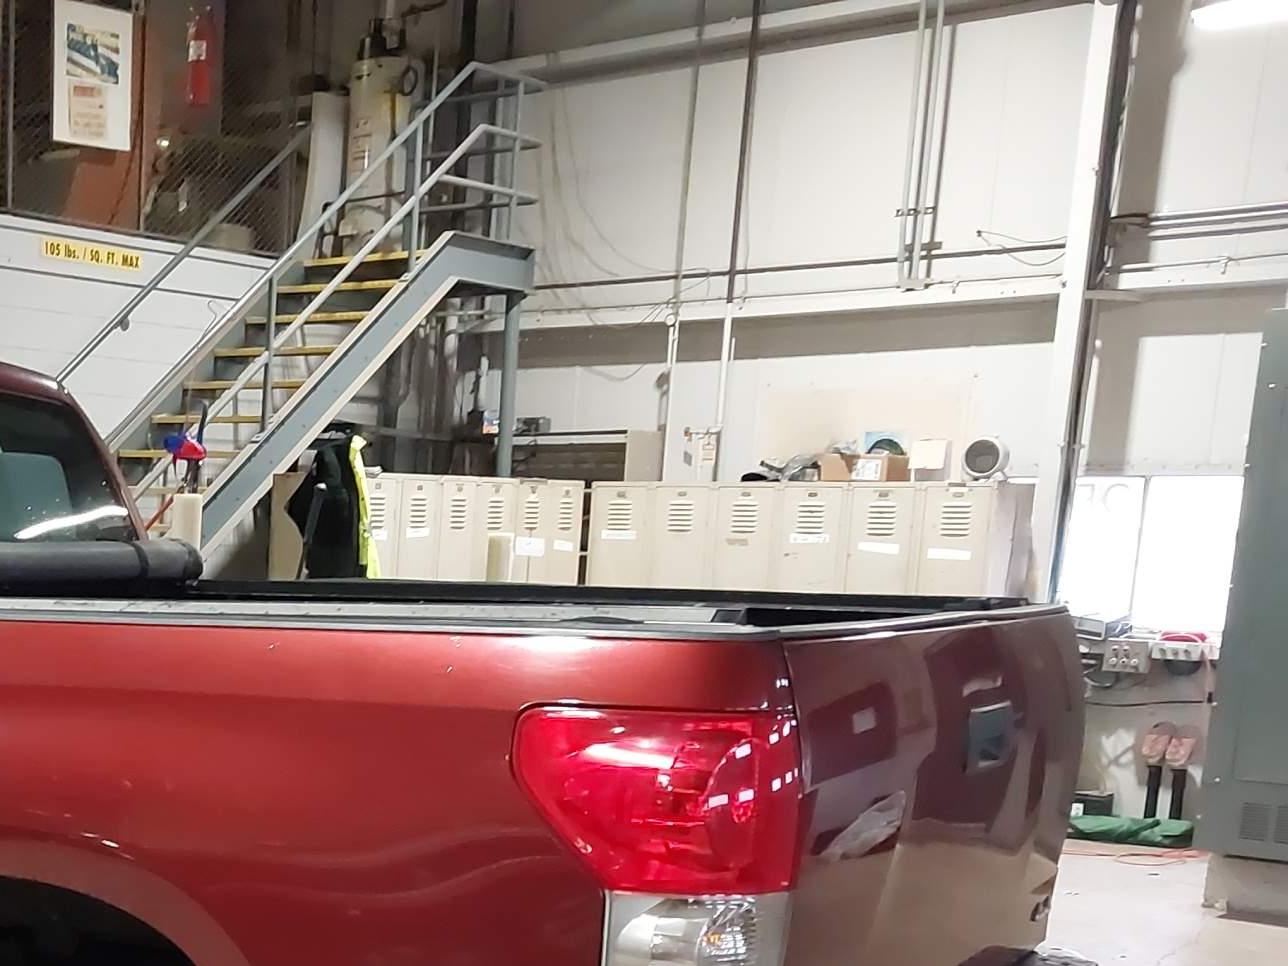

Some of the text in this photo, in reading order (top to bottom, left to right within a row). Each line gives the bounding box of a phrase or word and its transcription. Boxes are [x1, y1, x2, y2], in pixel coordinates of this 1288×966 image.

[45, 241, 61, 257] 105
[64, 244, 79, 259] lbs.
[90, 248, 103, 264] SQ.
[106, 251, 118, 265] FT.
[121, 253, 140, 268] MAX
